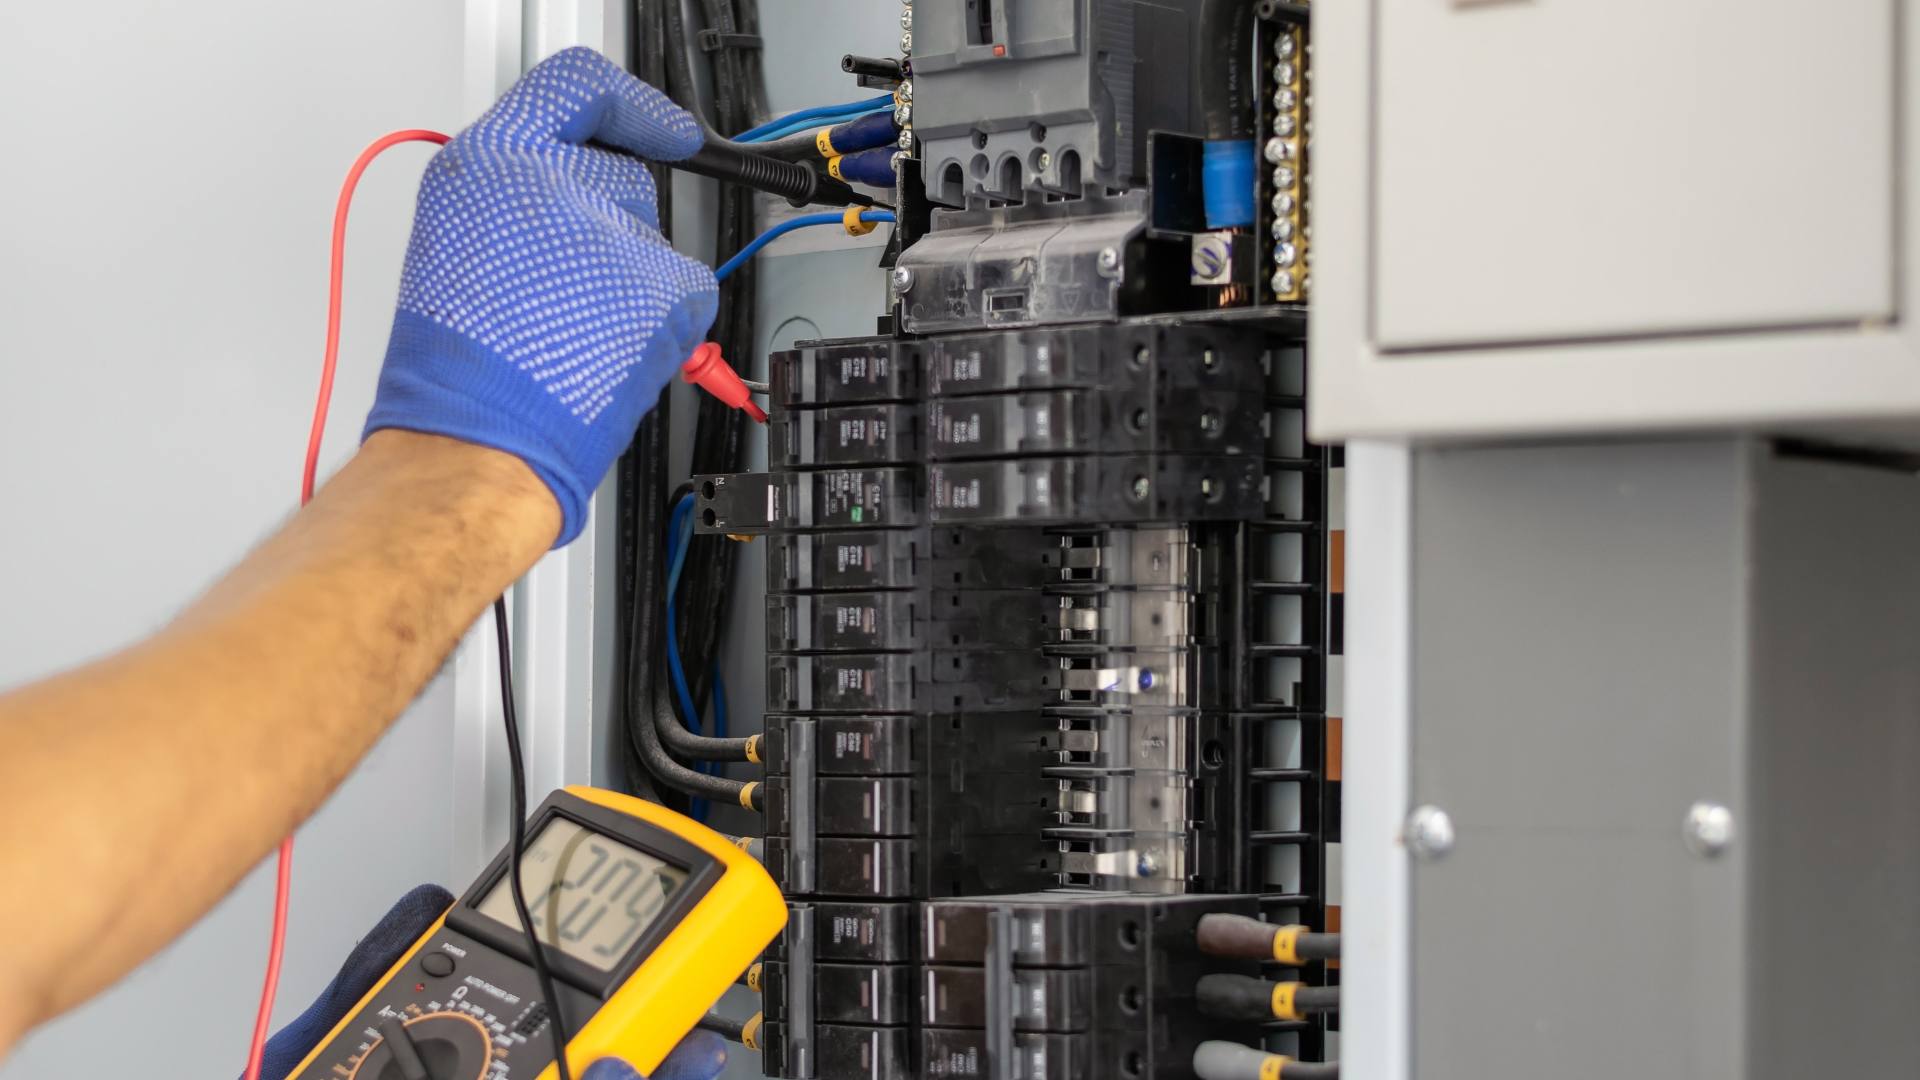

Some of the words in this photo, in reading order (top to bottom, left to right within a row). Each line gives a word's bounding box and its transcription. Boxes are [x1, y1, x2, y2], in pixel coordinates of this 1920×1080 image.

[819, 140, 826, 152] 2
[831, 165, 838, 176] 3
[747, 741, 752, 754] 2
[442, 943, 467, 958] POWER
[751, 973, 756, 985] 3
